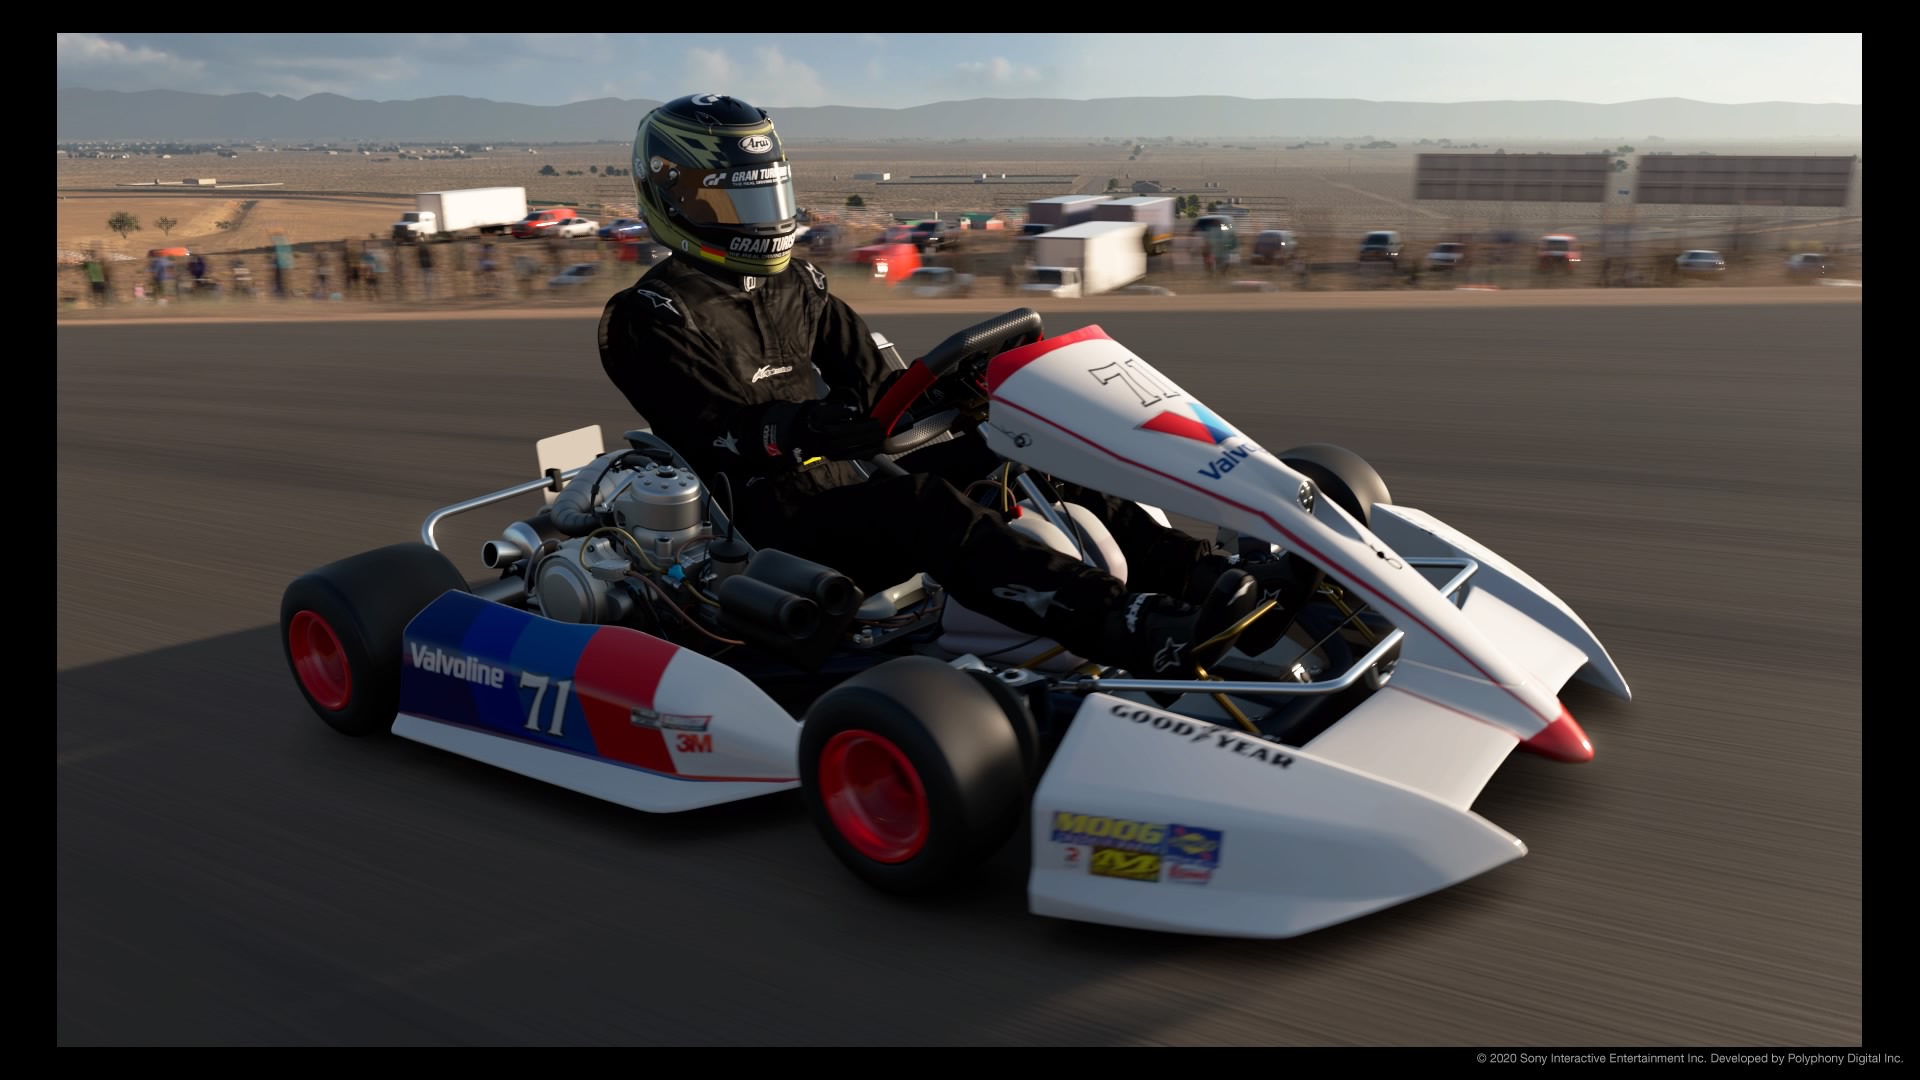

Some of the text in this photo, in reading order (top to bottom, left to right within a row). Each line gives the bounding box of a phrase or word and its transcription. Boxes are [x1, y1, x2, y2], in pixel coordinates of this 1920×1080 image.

[743, 137, 769, 149] Arai
[731, 169, 759, 183] GRAN
[729, 236, 770, 253] GRAN
[1088, 359, 1180, 407] 71
[410, 642, 504, 689] Valvoline
[519, 671, 573, 737] 71
[675, 733, 713, 753] 3M
[1054, 812, 1167, 846] MOOG
